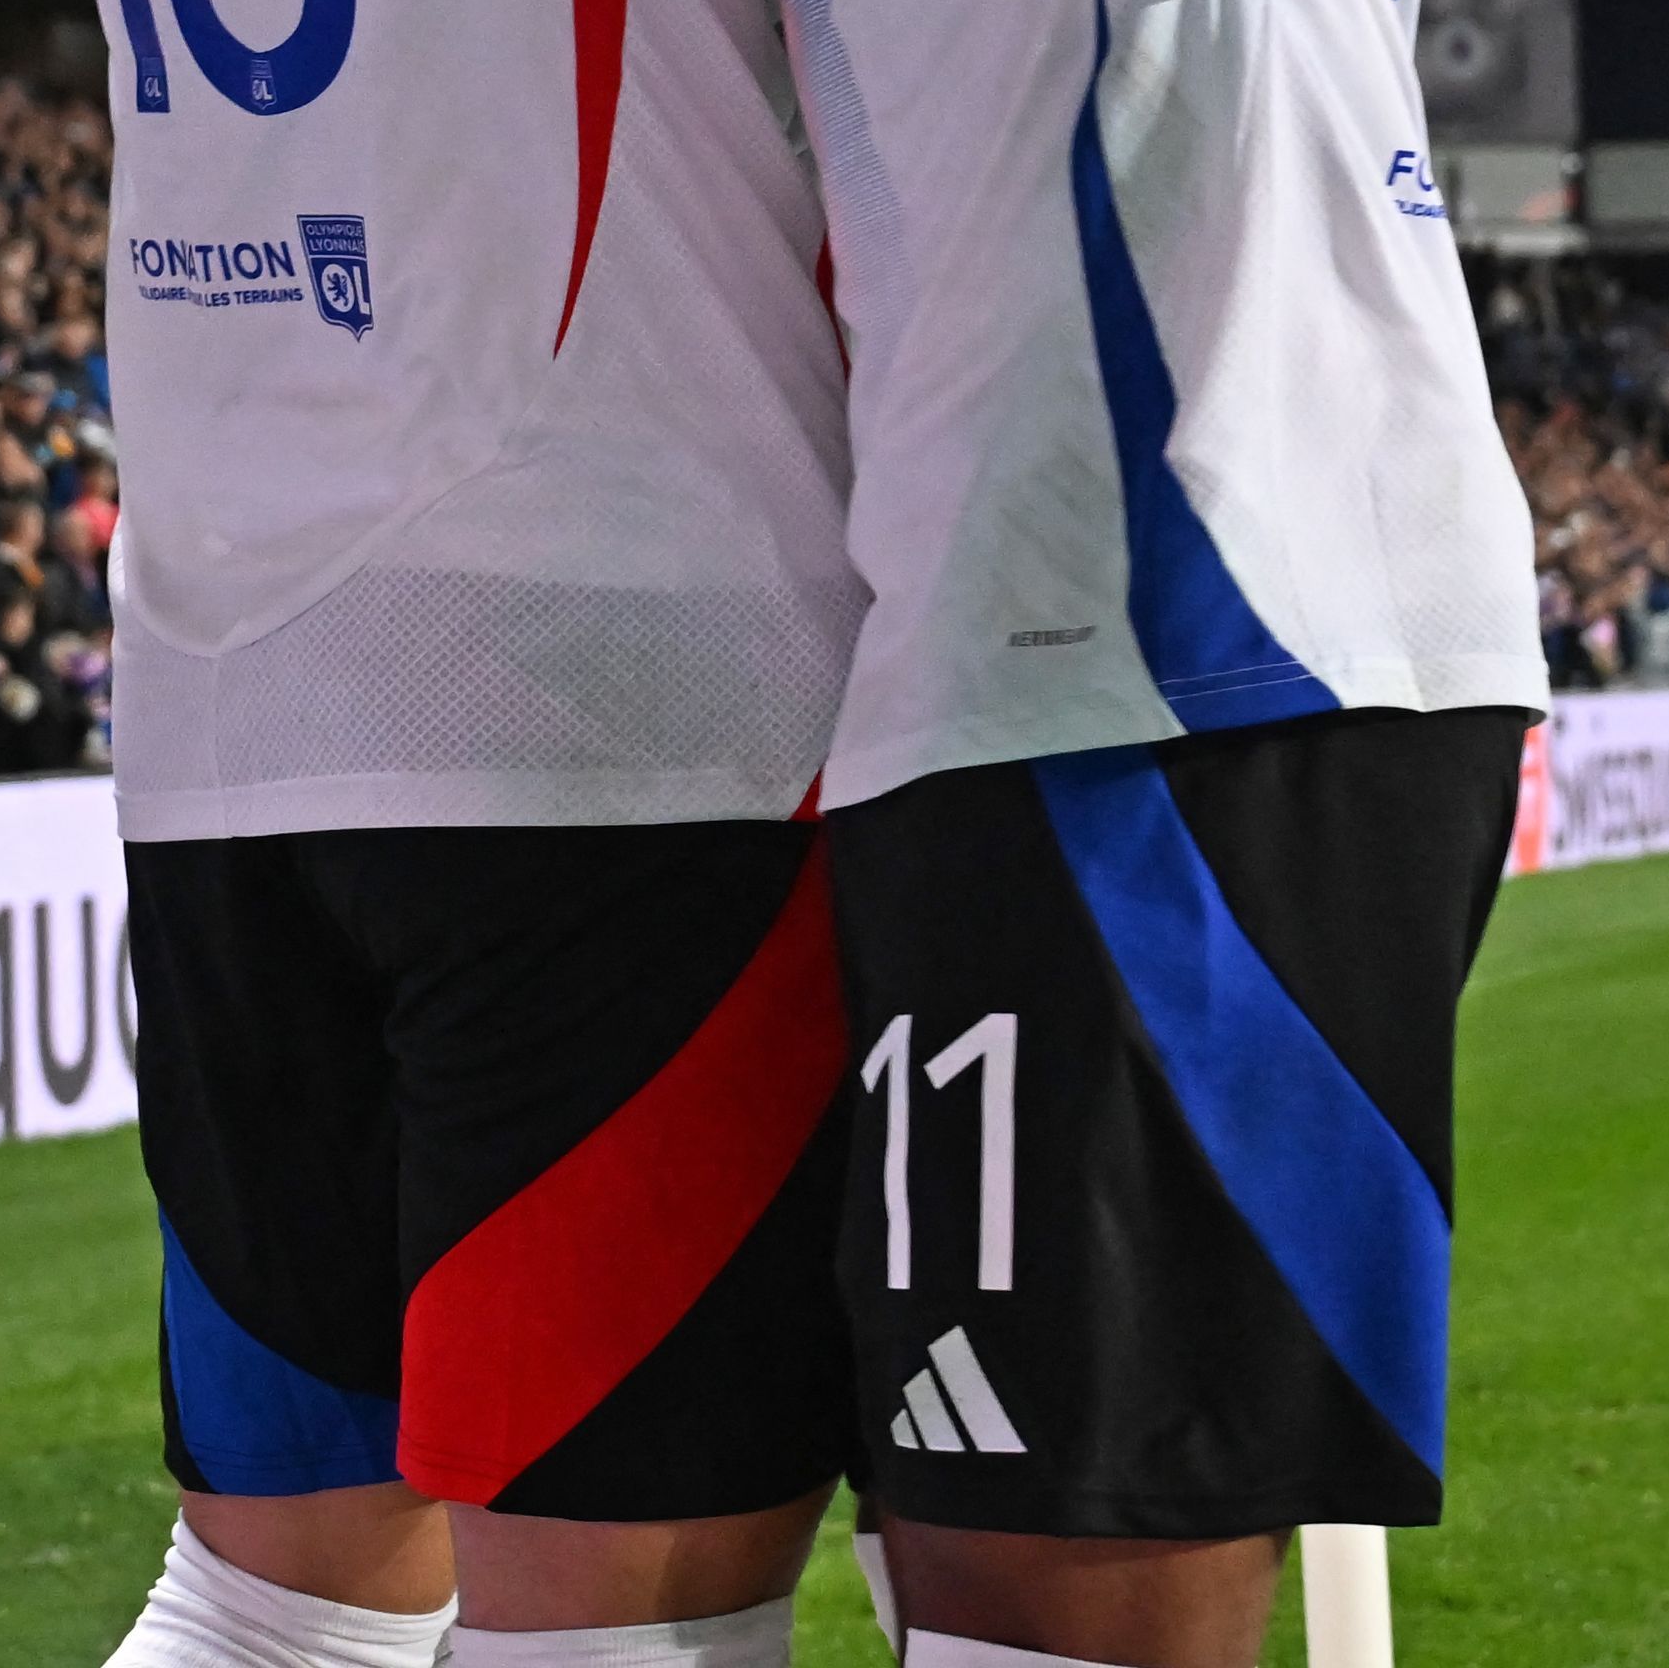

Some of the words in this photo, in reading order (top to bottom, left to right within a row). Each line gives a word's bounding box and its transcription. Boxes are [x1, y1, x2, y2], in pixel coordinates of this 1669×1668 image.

[204, 291, 231, 307] LES
[234, 288, 304, 305] TERRAINS
[860, 1012, 1018, 1291] 11
